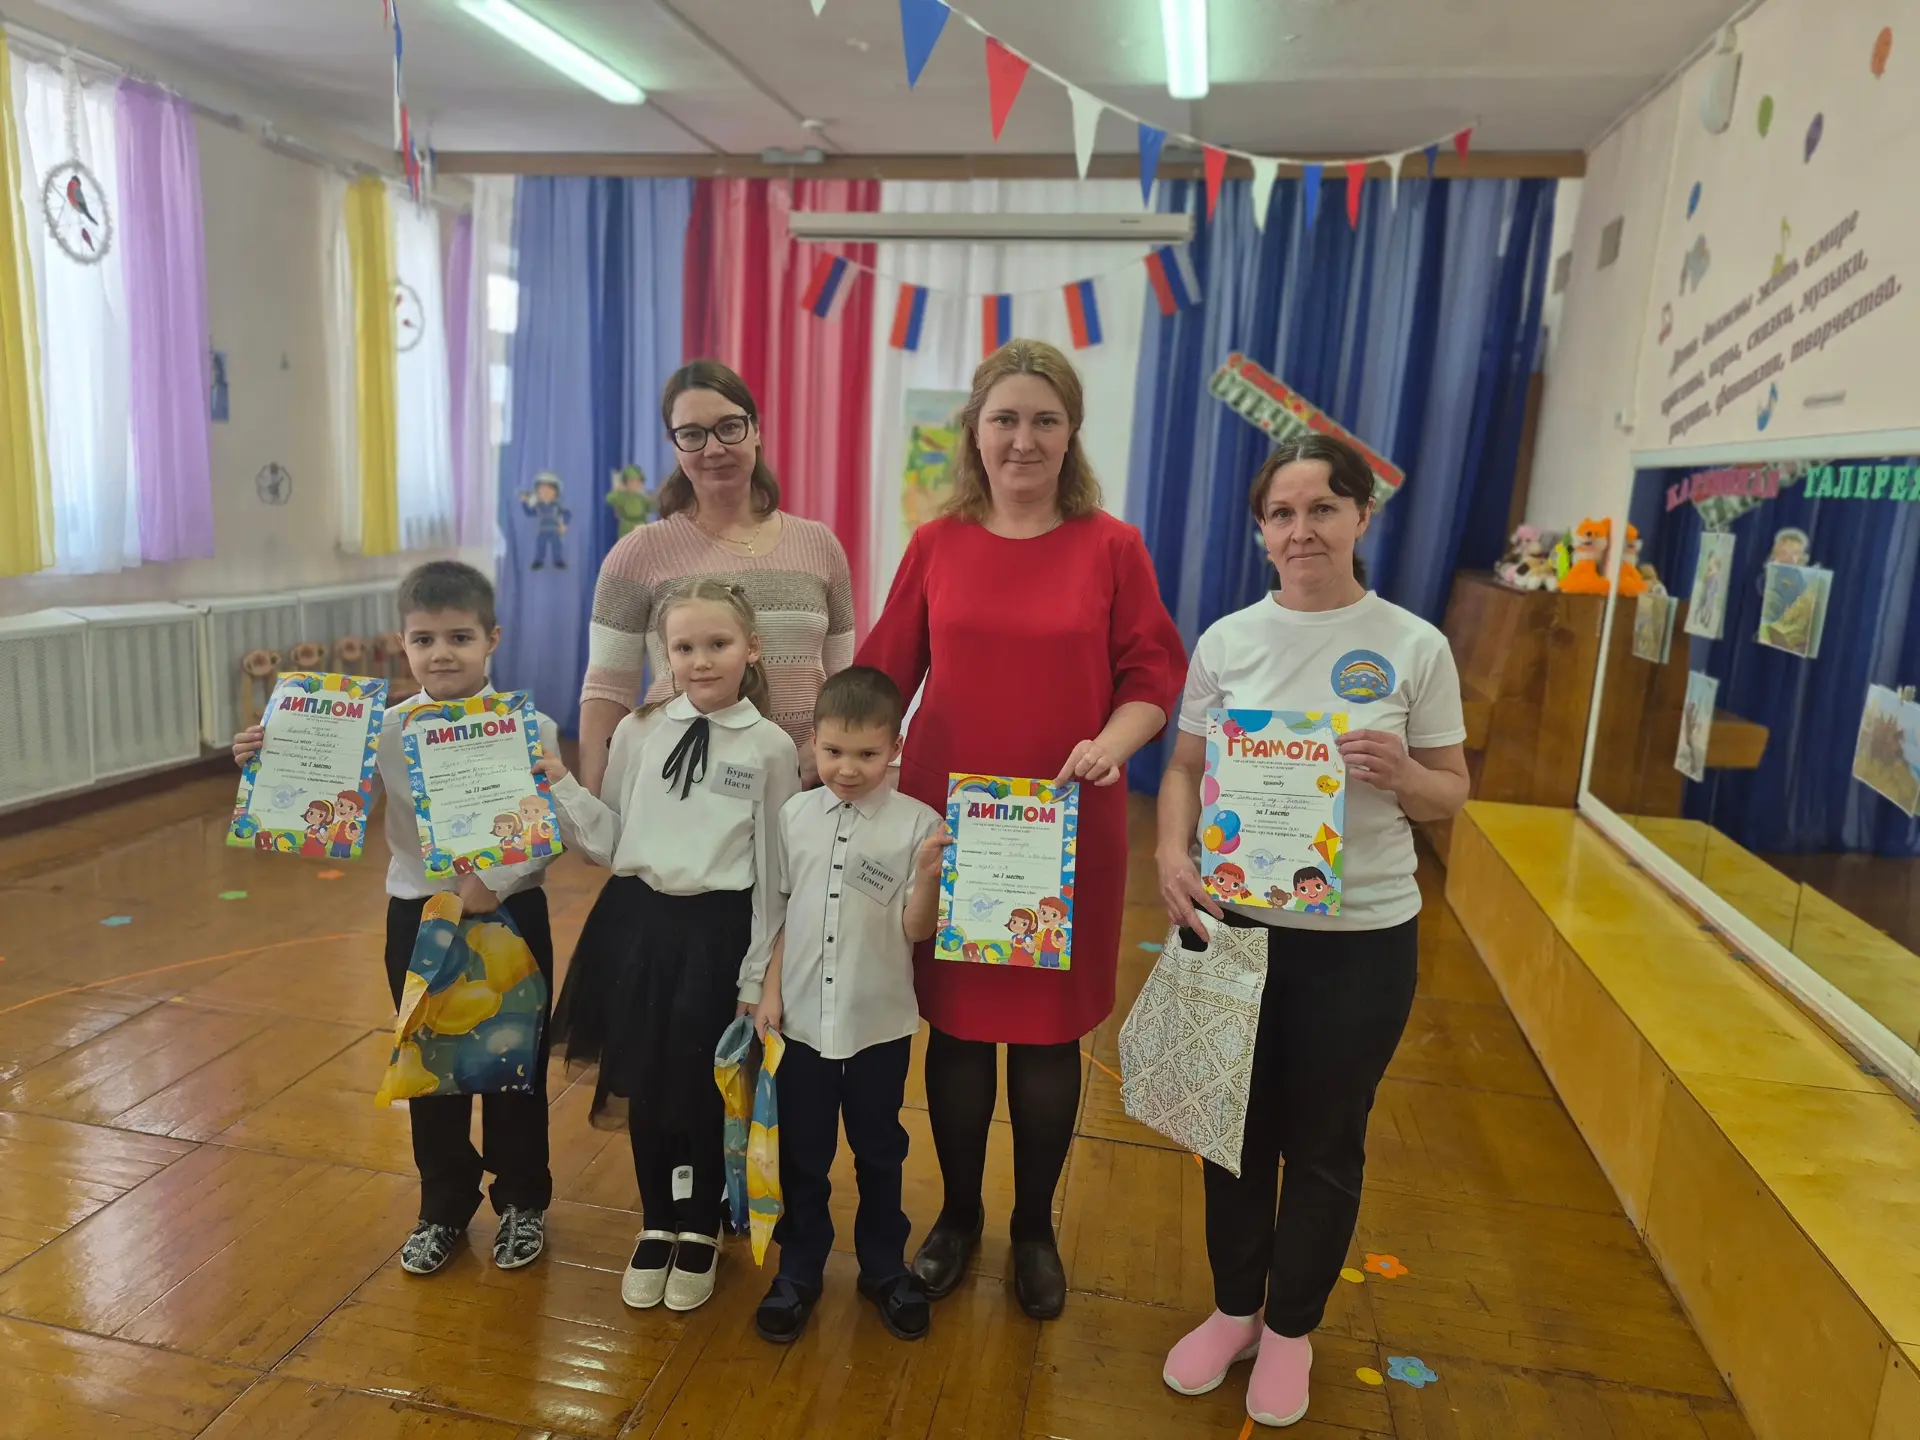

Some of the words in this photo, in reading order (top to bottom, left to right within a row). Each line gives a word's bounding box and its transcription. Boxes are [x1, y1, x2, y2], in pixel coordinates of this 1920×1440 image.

[1799, 249, 1868, 314] музыки,
[1790, 274, 1902, 364] творчества.
[279, 696, 364, 719] ДИПЛОМ
[426, 718, 517, 746] ДИПЛОМ
[1227, 737, 1330, 763] ГРАМОТА
[724, 777, 751, 790] Настя
[727, 766, 755, 780] Бурак
[480, 783, 501, 792] место
[967, 802, 1056, 824] ДИПЛОМ
